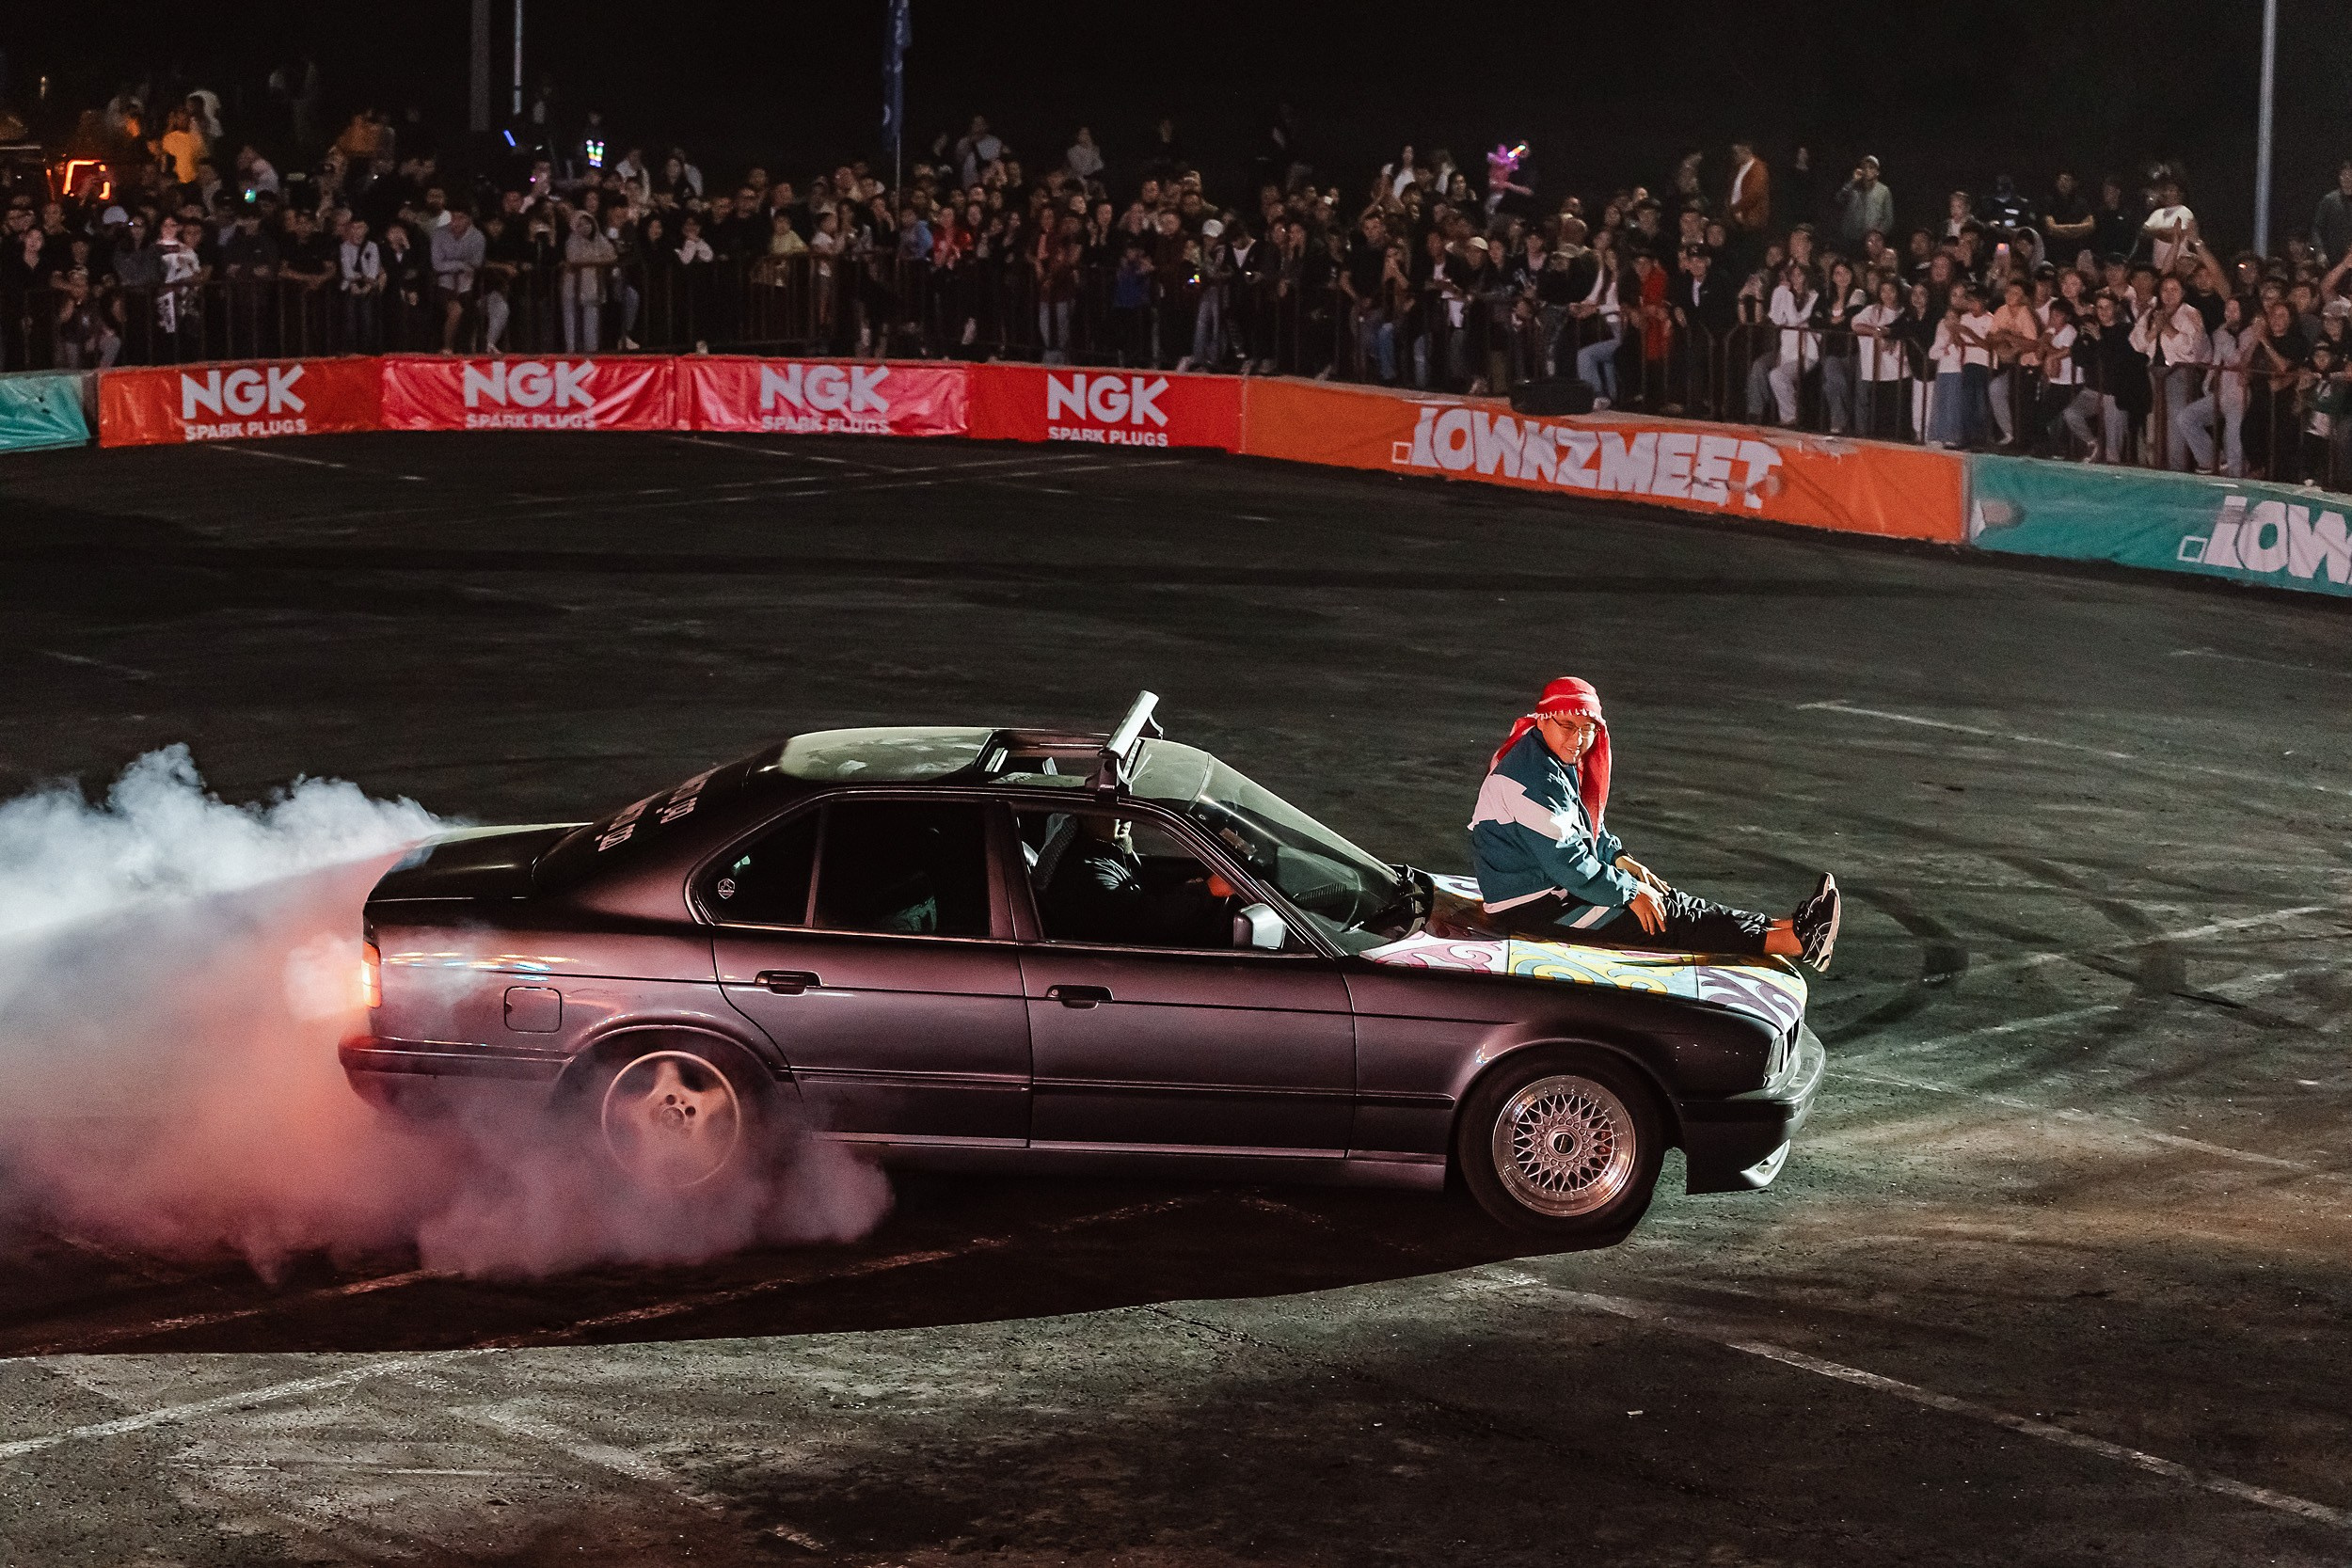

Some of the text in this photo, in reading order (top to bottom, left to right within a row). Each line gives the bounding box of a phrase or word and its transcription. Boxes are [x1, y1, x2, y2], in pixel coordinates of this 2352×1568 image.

[182, 365, 306, 420] NGK
[464, 360, 596, 408] NGK
[760, 363, 889, 414] NGK
[1047, 373, 1169, 427] NGK
[184, 419, 307, 441] SPARK PLUGS
[467, 413, 528, 429] SPARK
[762, 416, 890, 434] SPARK PLUGS
[1048, 426, 1168, 447] SPARK PLUGS
